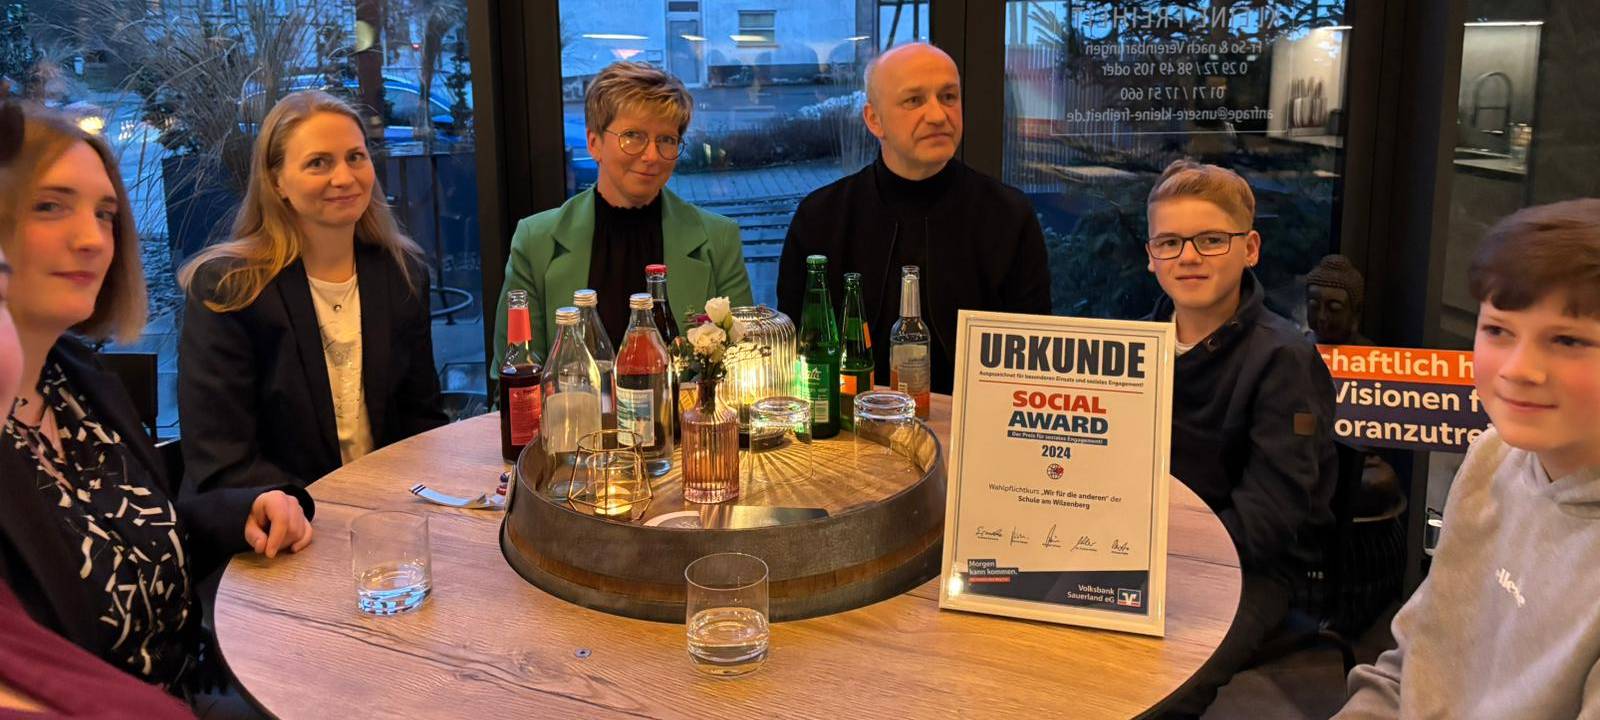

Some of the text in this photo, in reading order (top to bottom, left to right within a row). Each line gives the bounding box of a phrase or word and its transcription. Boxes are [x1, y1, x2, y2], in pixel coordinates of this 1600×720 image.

[980, 332, 1145, 379] URKUNDE
[1013, 390, 1106, 414] SOCIAL
[1008, 410, 1108, 435] AWARD
[1041, 445, 1071, 459] 2024
[989, 483, 1040, 495] Wahlpflichtkurs
[1067, 490, 1077, 498] die
[1110, 495, 1121, 503] der
[1018, 495, 1040, 504] Schule
[969, 560, 995, 568] Morgen
[1067, 591, 1104, 602] Sauerland
[1078, 584, 1115, 595] Volksbank
